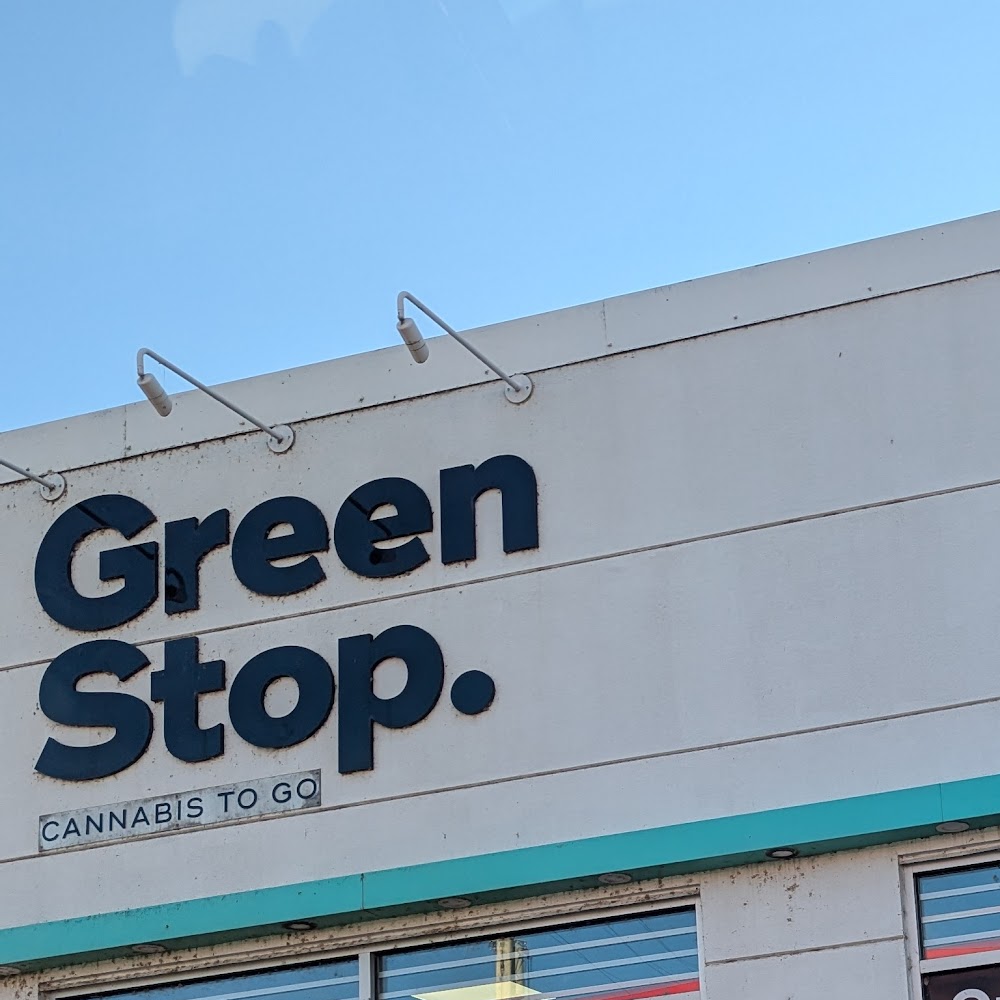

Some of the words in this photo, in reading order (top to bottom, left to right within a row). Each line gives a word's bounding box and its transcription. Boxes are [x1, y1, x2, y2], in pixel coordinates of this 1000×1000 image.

[35, 454, 539, 631] Green
[34, 624, 495, 781] Stop.
[41, 796, 204, 843] CANNABIS
[217, 787, 258, 814] TO
[271, 776, 318, 805] GO
